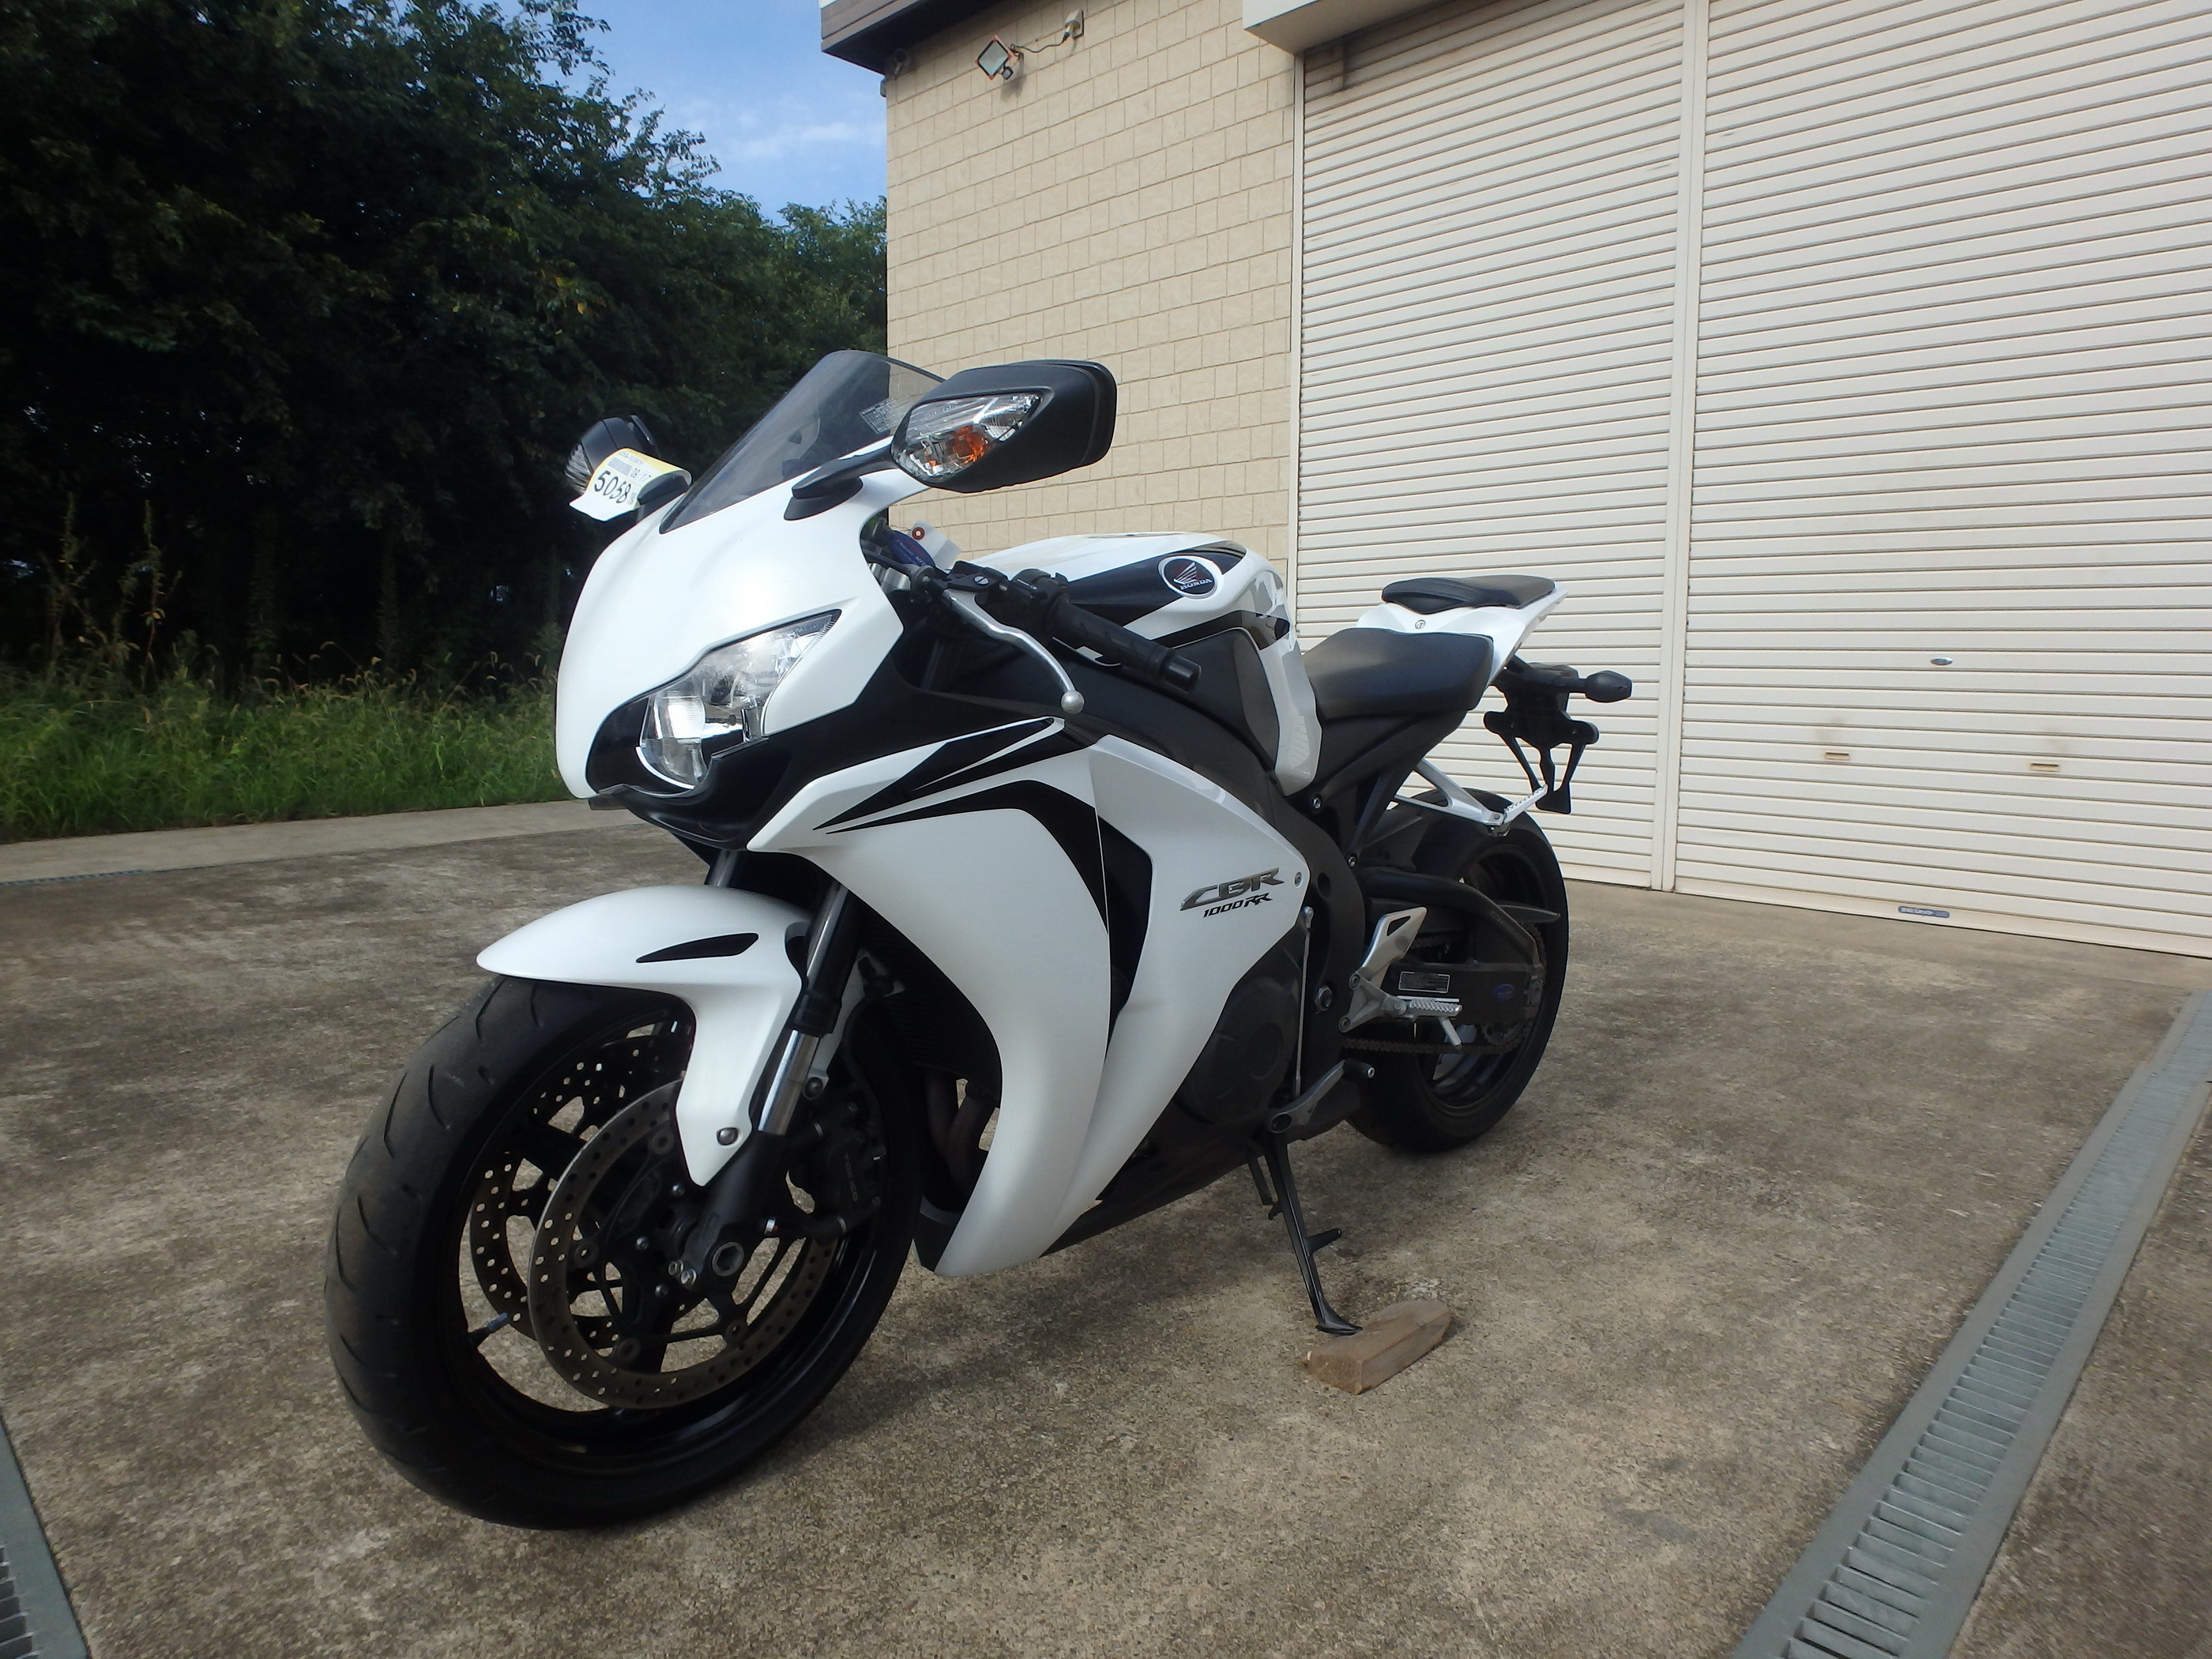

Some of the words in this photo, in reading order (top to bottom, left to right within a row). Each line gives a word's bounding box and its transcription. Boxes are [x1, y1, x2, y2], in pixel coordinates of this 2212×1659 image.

[594, 469, 632, 504] 5058
[1179, 578, 1213, 591] HONDA
[1180, 867, 1285, 912] CBR
